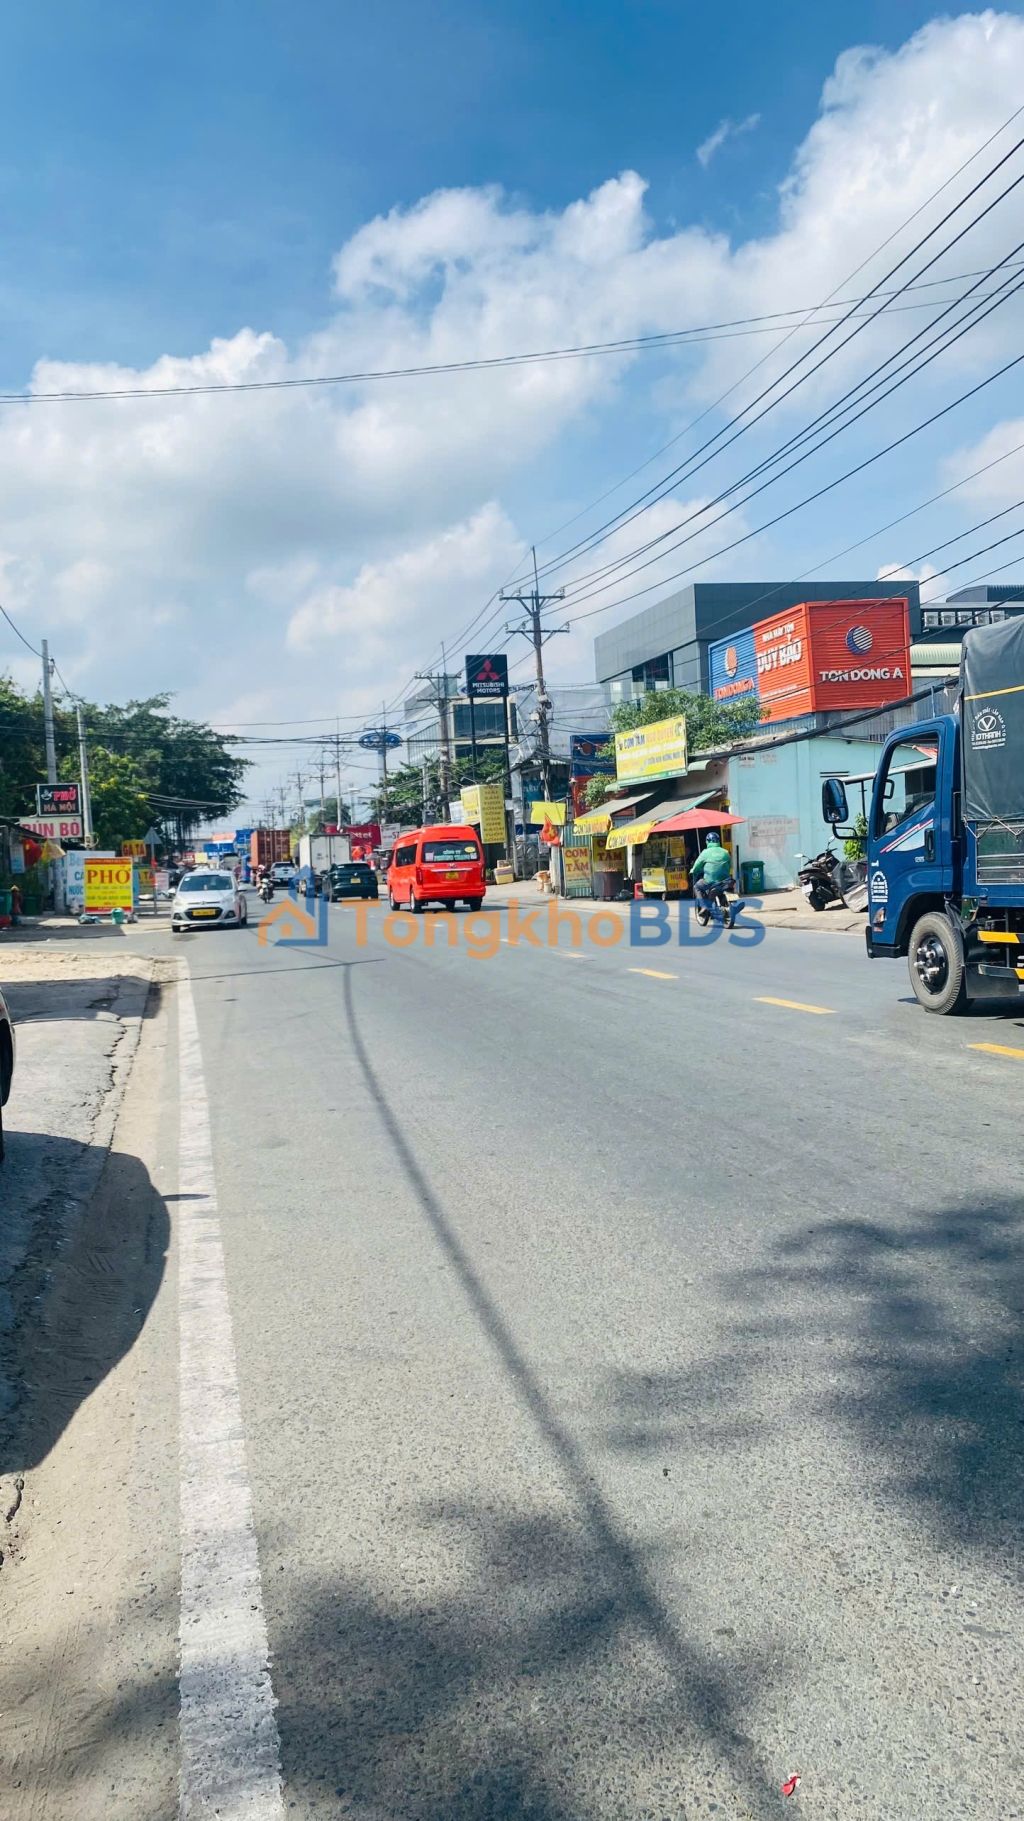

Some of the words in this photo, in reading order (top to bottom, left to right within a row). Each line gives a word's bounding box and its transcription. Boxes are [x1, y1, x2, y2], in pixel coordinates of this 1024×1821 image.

[757, 647, 779, 674] DUY
[53, 787, 77, 801] PHỞ
[87, 865, 131, 885] PHỞ
